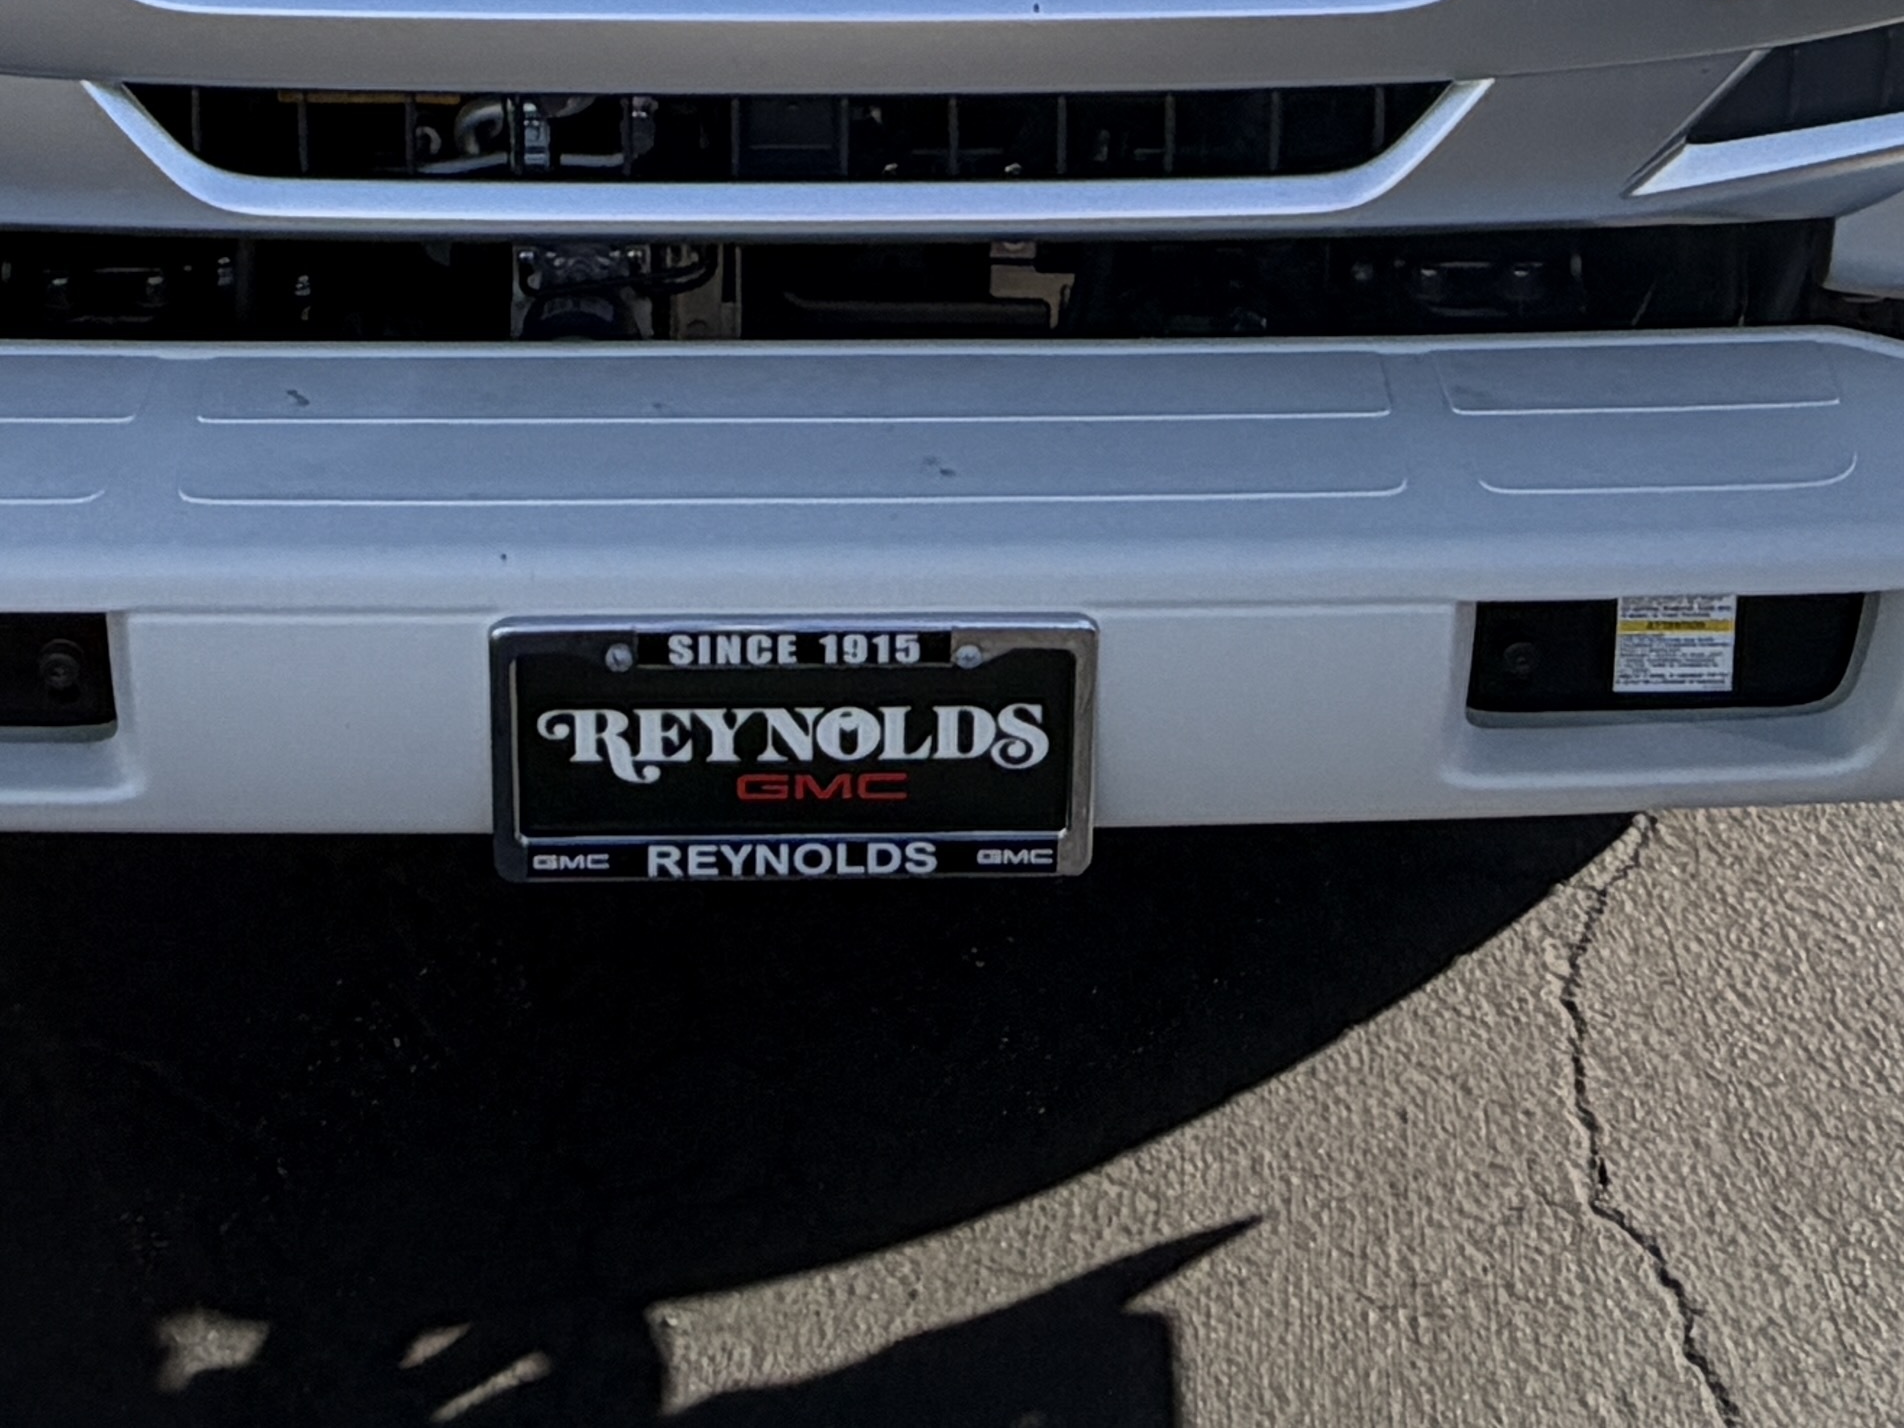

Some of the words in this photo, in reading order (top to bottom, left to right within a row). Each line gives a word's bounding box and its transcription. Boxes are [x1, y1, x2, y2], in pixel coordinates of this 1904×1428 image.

[667, 633, 797, 665] SINCE
[818, 633, 921, 665] 1915
[535, 703, 1050, 784] REYNOLDS
[736, 772, 908, 801] GMC
[533, 853, 610, 871] GMC
[647, 843, 938, 878] REYNOLDS
[977, 848, 1053, 866] GMC
